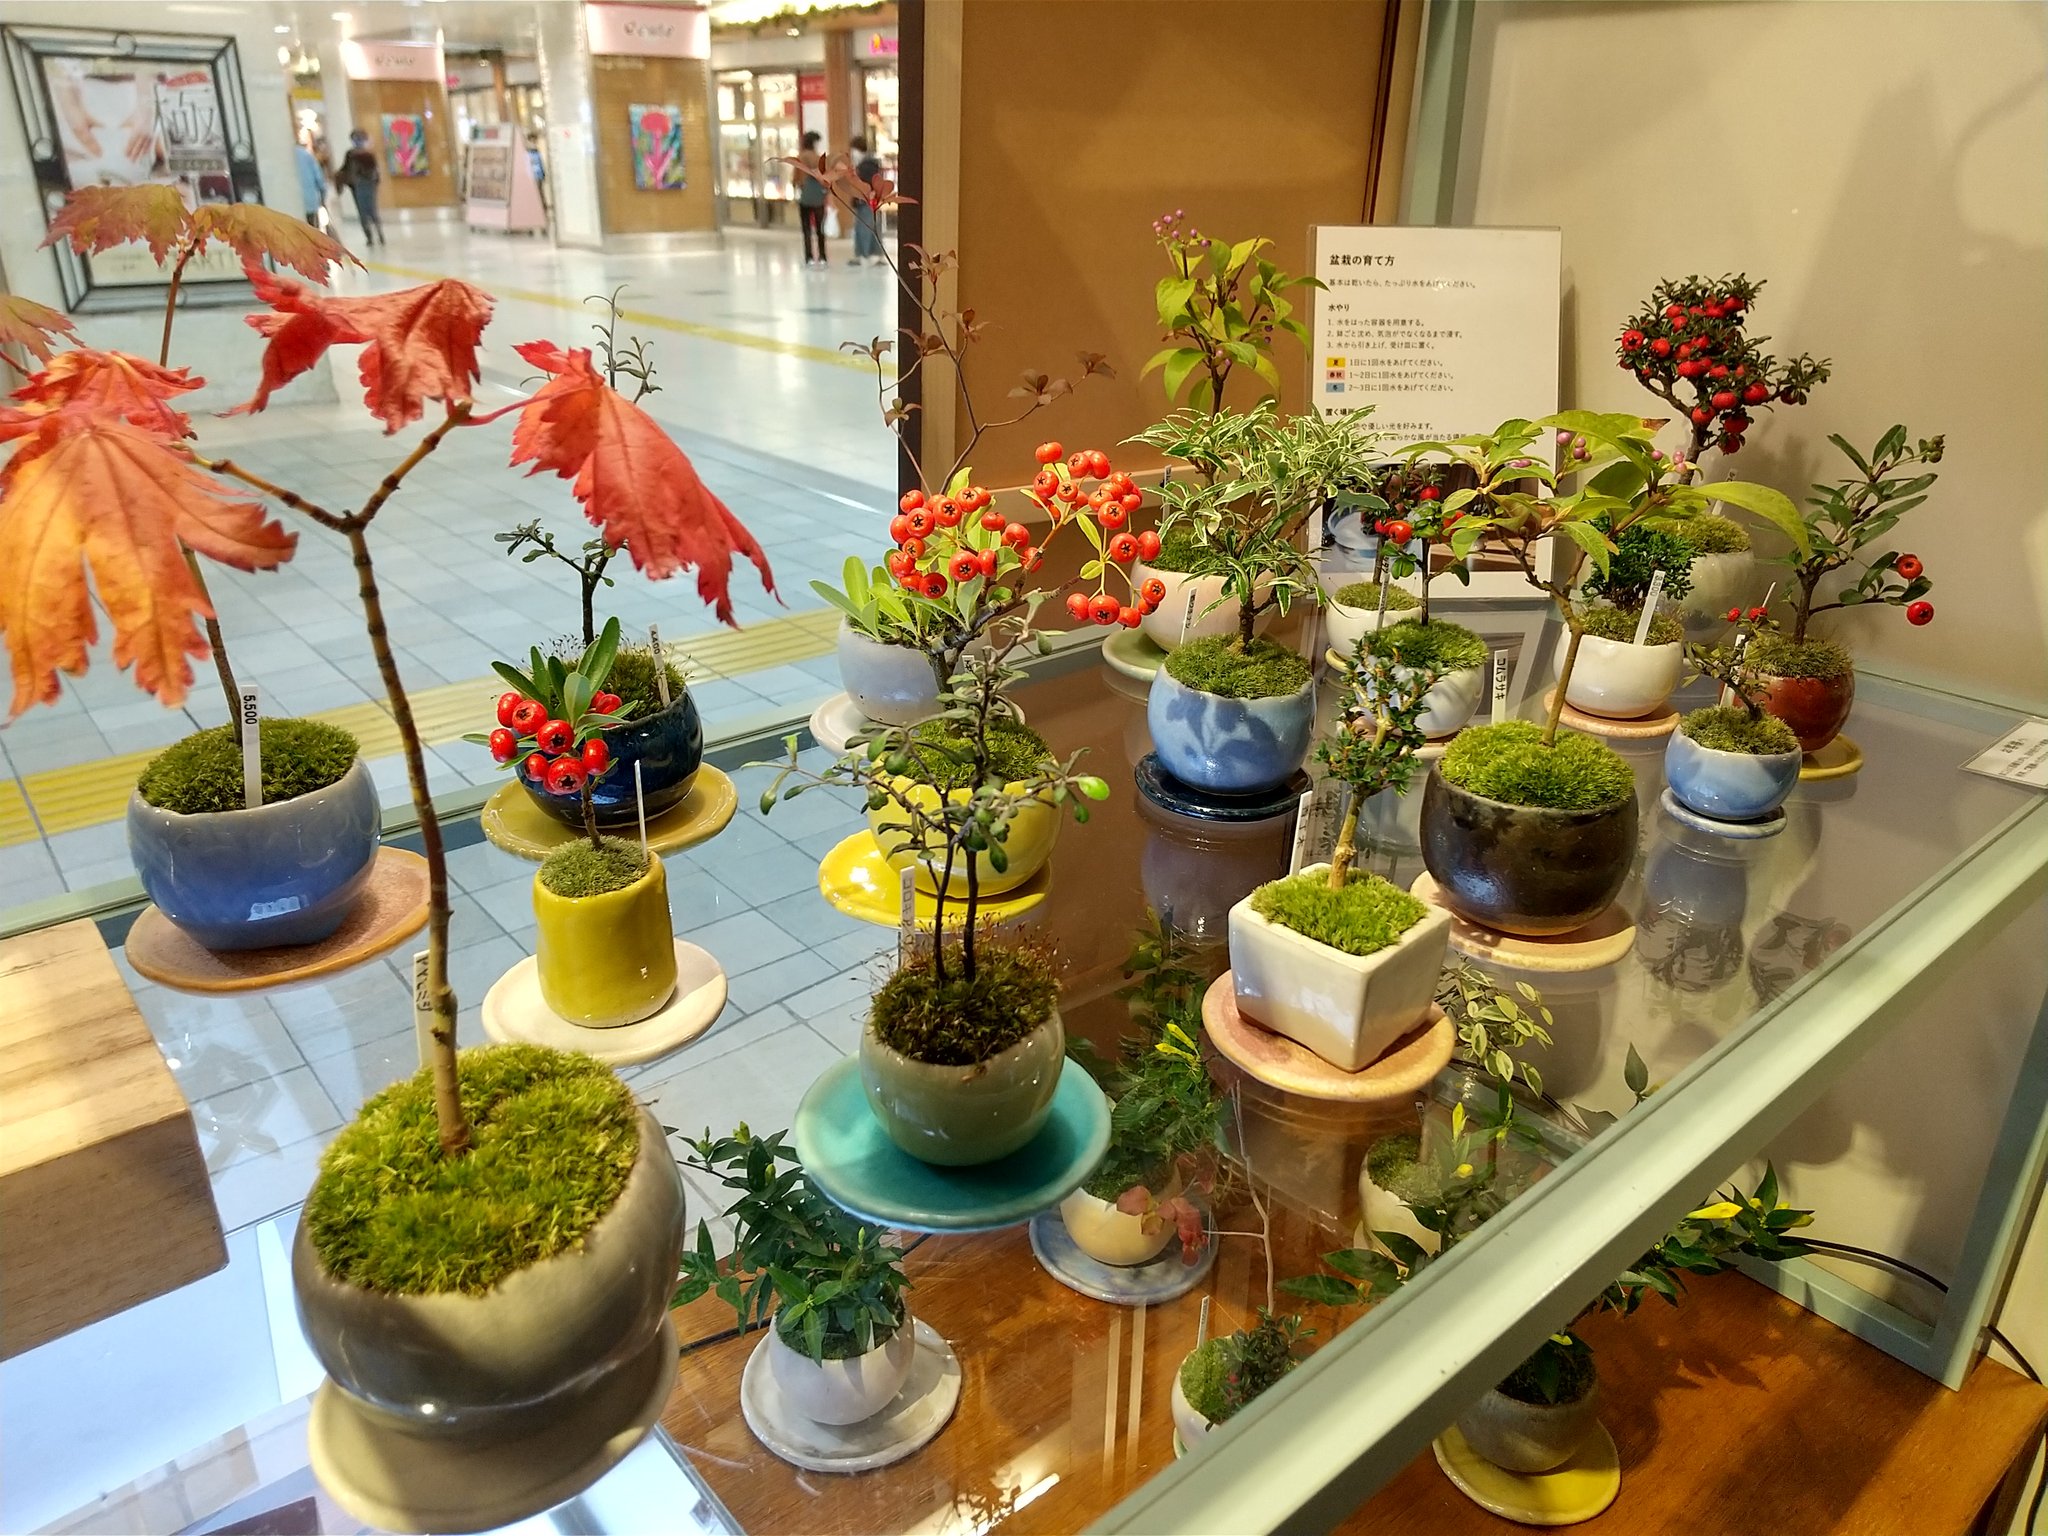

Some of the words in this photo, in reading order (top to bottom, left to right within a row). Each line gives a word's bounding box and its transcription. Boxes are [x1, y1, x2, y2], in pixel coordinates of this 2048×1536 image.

[1329, 254, 1395, 266] 盆栽の育て方
[1327, 303, 1350, 312] 水やり
[1336, 318, 1425, 327] 水をはった容器を用意する。
[1349, 358, 1444, 367] 1日に1回水をあげてください。
[1495, 657, 1506, 701] コムラサキ
